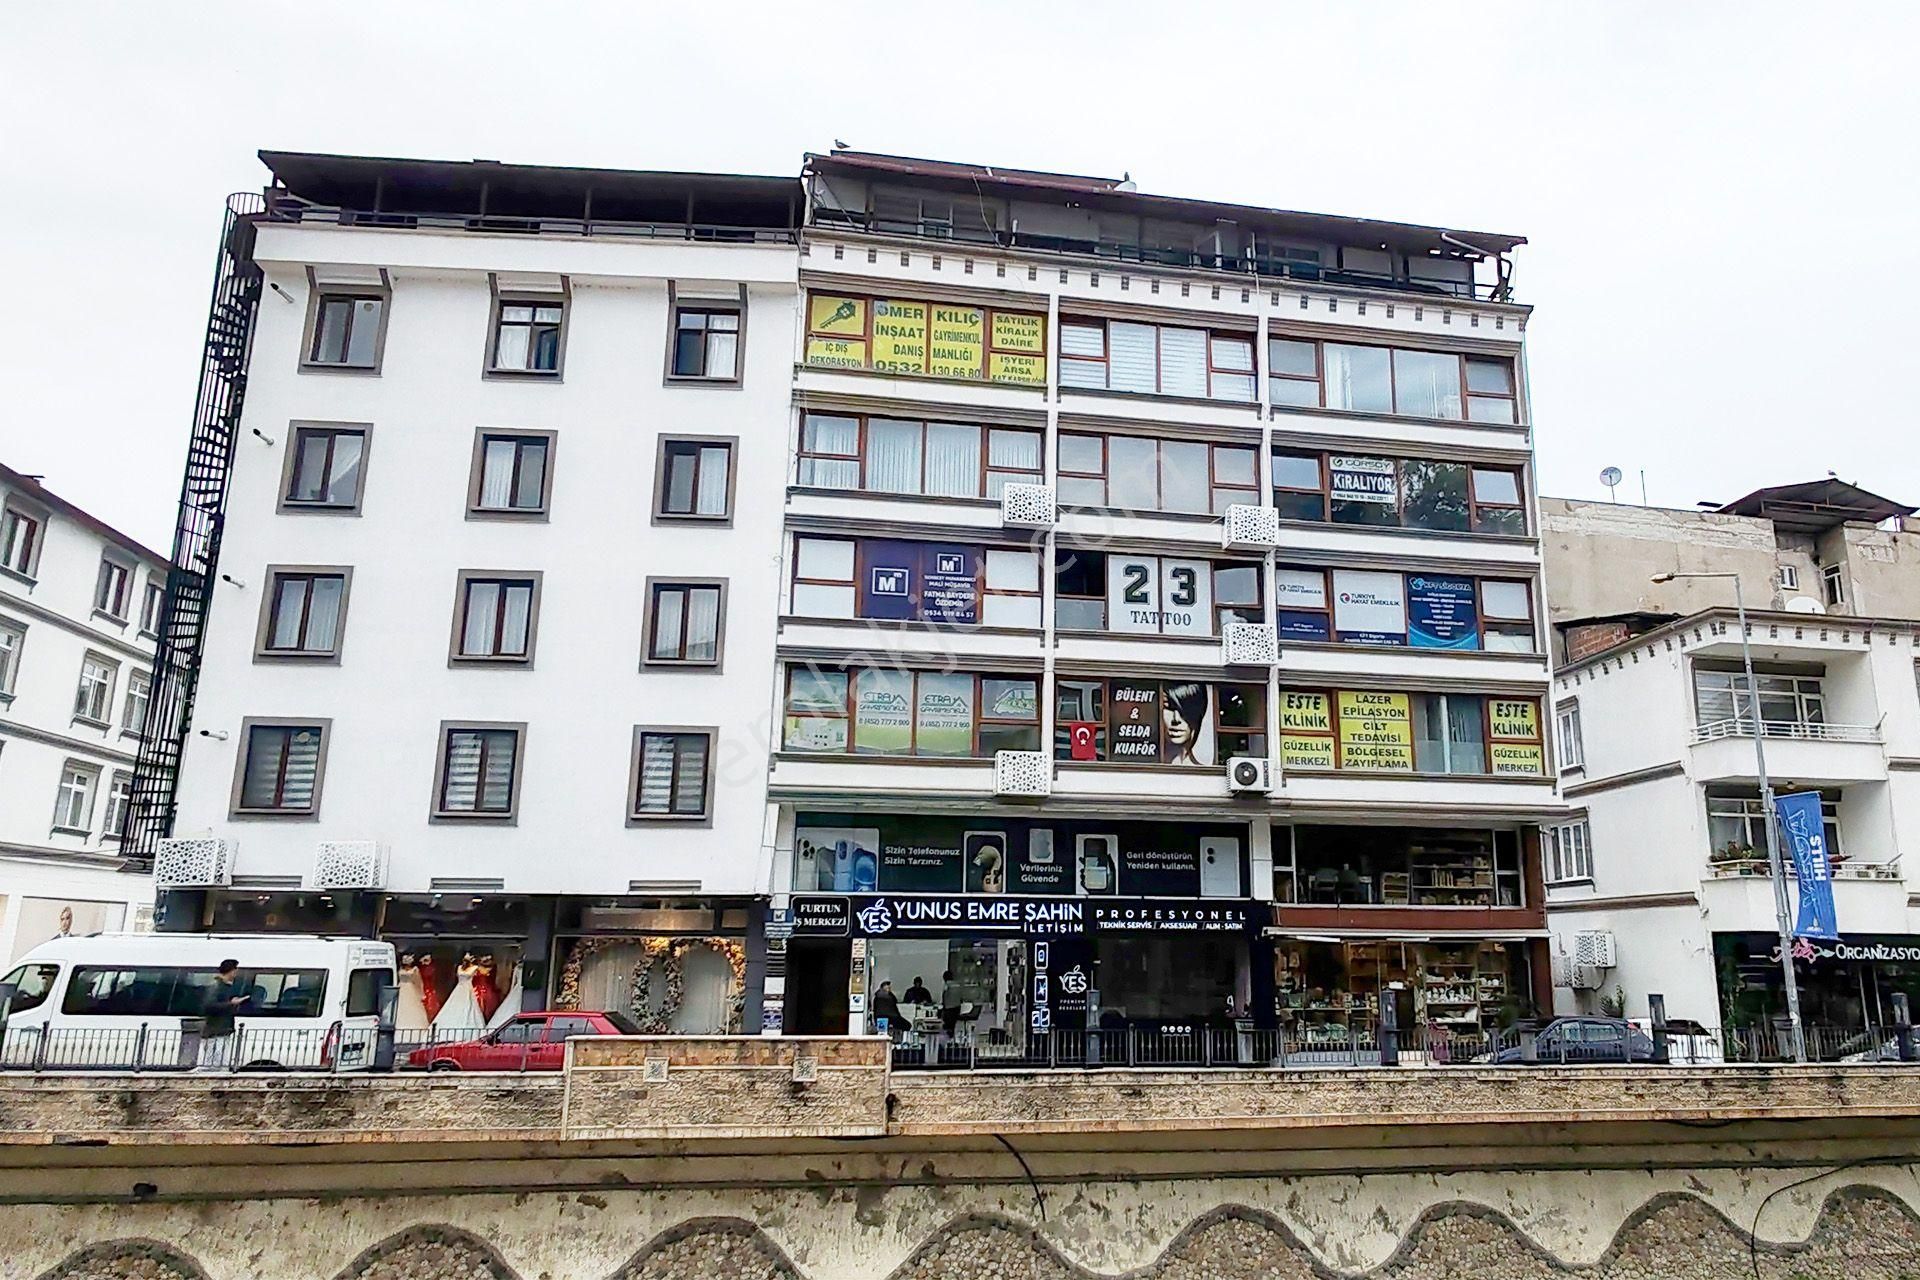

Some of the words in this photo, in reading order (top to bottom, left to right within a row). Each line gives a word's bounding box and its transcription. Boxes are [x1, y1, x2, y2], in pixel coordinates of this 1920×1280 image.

[937, 310, 979, 328] KILIÇ
[876, 322, 925, 340] İNŞAAT
[934, 329, 981, 344] GAYRİMENKUL
[996, 325, 1039, 337] KİRALIK
[1001, 337, 1034, 348] DAİRE
[894, 344, 924, 359] DANIŞ
[933, 346, 973, 361] MANLIĞI
[810, 355, 862, 368] DEKORASYON
[875, 360, 922, 374] 0532
[1003, 366, 1032, 376] ARSA
[1131, 611, 1192, 626] TATTOO
[1115, 687, 1156, 702] BÜLENT
[1356, 695, 1392, 705] LAZER
[1287, 694, 1322, 710] ESTE
[1130, 707, 1139, 719] &
[1343, 706, 1405, 717] EPİLASYON
[1496, 703, 1528, 718] ESTE
[1284, 712, 1328, 728] KLİNİK
[1119, 725, 1151, 737] SELDA
[1363, 721, 1387, 731] CİLT
[1493, 720, 1534, 736] KLİNİK
[1350, 733, 1401, 742] TEDAVİSİ
[1115, 741, 1157, 755] KUAFÖR
[1284, 740, 1331, 752] GÜZELLİK
[1347, 747, 1405, 757] BÖLGESEL
[1494, 748, 1540, 759] GÜZELLİK
[1286, 756, 1329, 766] MERKEZİ
[1345, 759, 1408, 768] ZAYIFLAMA
[1497, 763, 1538, 773] MERKEZİ
[884, 846, 906, 855] Sizin
[908, 846, 961, 857] Telefonunuz
[884, 856, 906, 865] Sizin
[1809, 834, 1827, 881] HILLS
[1020, 863, 1063, 873] Verileriniz
[1126, 862, 1160, 870] Yeniden
[1021, 874, 1060, 883] Güvende
[800, 904, 841, 913] FURTUN
[894, 901, 961, 920] YUNUS
[968, 902, 1020, 920] EMRE
[1025, 903, 1083, 922] ŞAHİN
[1096, 909, 1246, 920] PROFESYONEL
[804, 916, 847, 926] MERKEZİ
[856, 911, 892, 930] YES
[1100, 920, 1126, 929] TEKNİK
[1127, 921, 1152, 929] SERVİS
[1160, 922, 1198, 930] AKSESUAR
[1023, 922, 1084, 933] İLETİŞİM
[1059, 975, 1087, 992] YES
